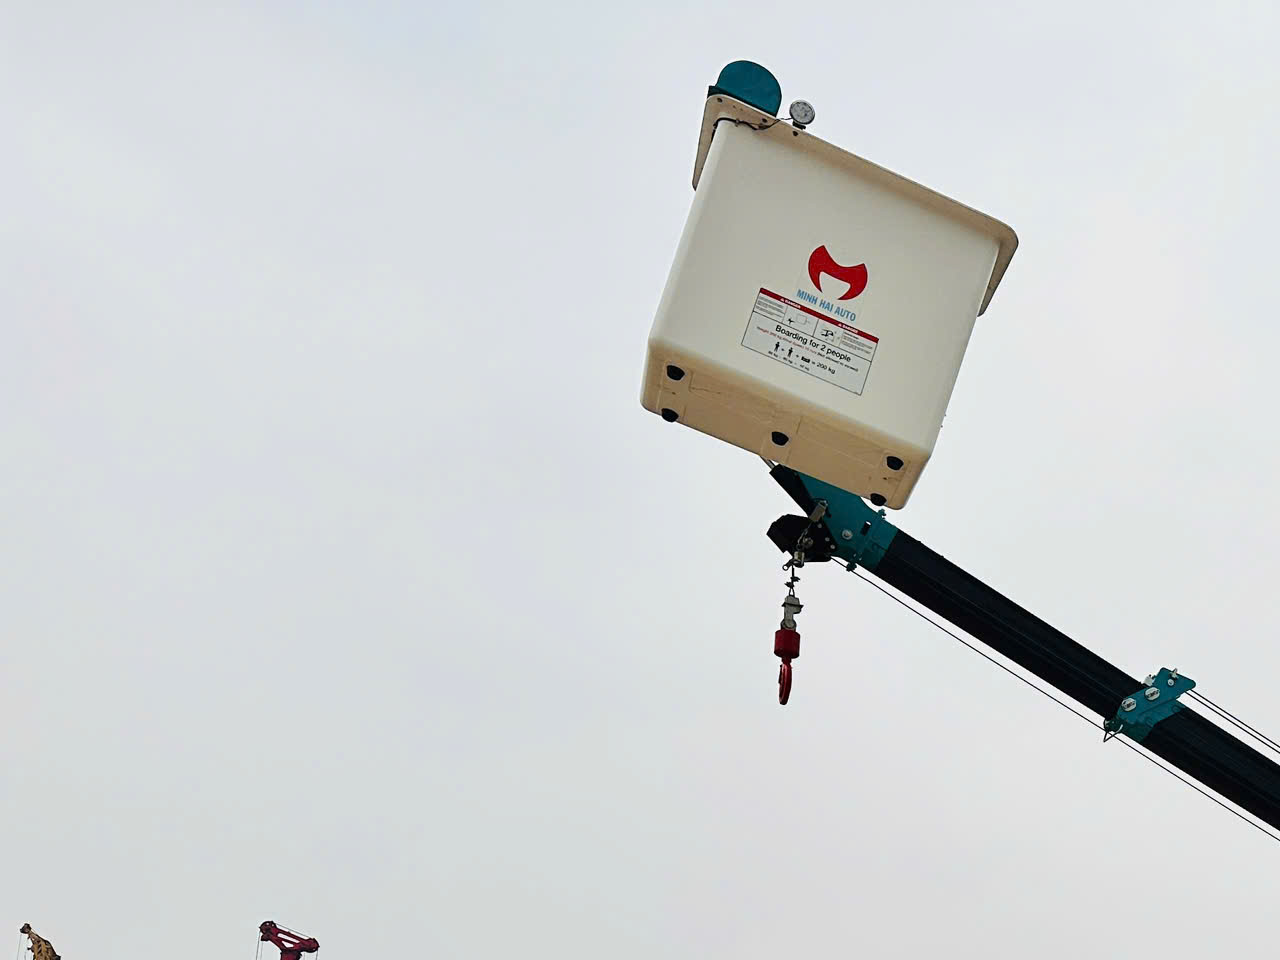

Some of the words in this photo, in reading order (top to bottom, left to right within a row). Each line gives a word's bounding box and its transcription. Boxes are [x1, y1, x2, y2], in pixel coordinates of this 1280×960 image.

[796, 289, 818, 305] MINH
[819, 299, 833, 313] HAI
[834, 306, 857, 322] AUTO
[775, 324, 808, 345] Boarding
[809, 339, 820, 349] for
[820, 344, 826, 352] 2
[826, 347, 851, 362] people
